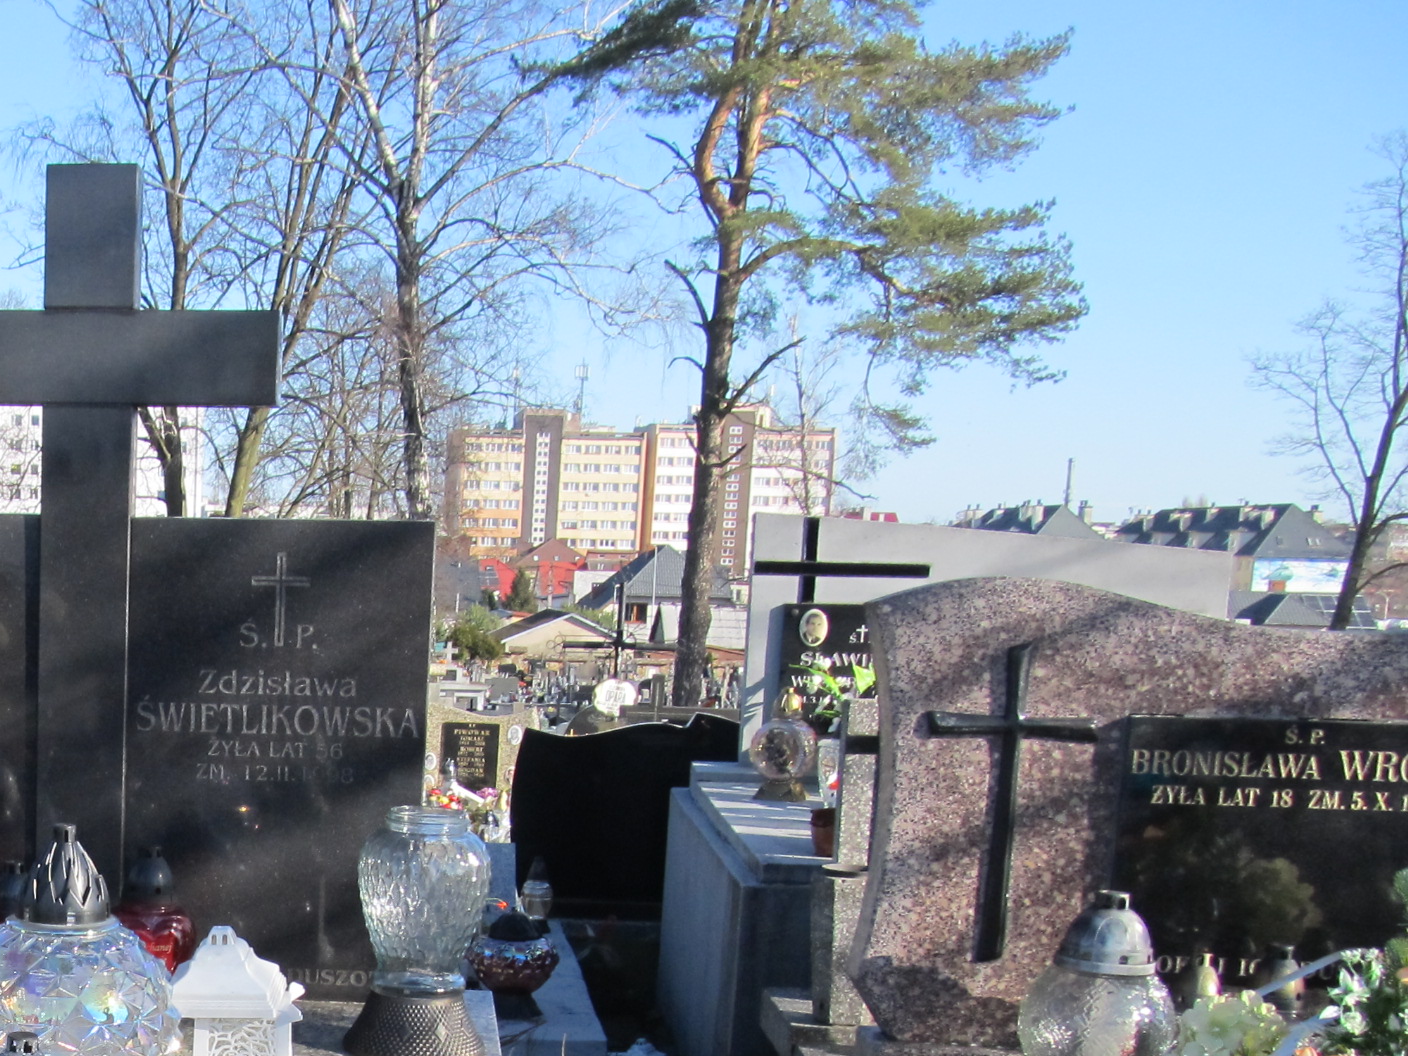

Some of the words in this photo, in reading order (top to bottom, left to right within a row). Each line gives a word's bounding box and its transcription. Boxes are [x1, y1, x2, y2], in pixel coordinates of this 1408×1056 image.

[198, 669, 358, 698] Zdzisława
[136, 694, 420, 738] ŚWIETLIKOWSKA
[207, 736, 261, 758] ŻYŁA
[269, 741, 308, 759] LAT
[1132, 749, 1321, 780] BRONISŁAWA
[1217, 786, 1260, 807] LAT
[1270, 788, 1292, 807] 18
[1308, 790, 1345, 810] ZM.
[1350, 791, 1367, 810] 5.
[1373, 791, 1393, 811] X.
[287, 968, 374, 987] DUSZO
